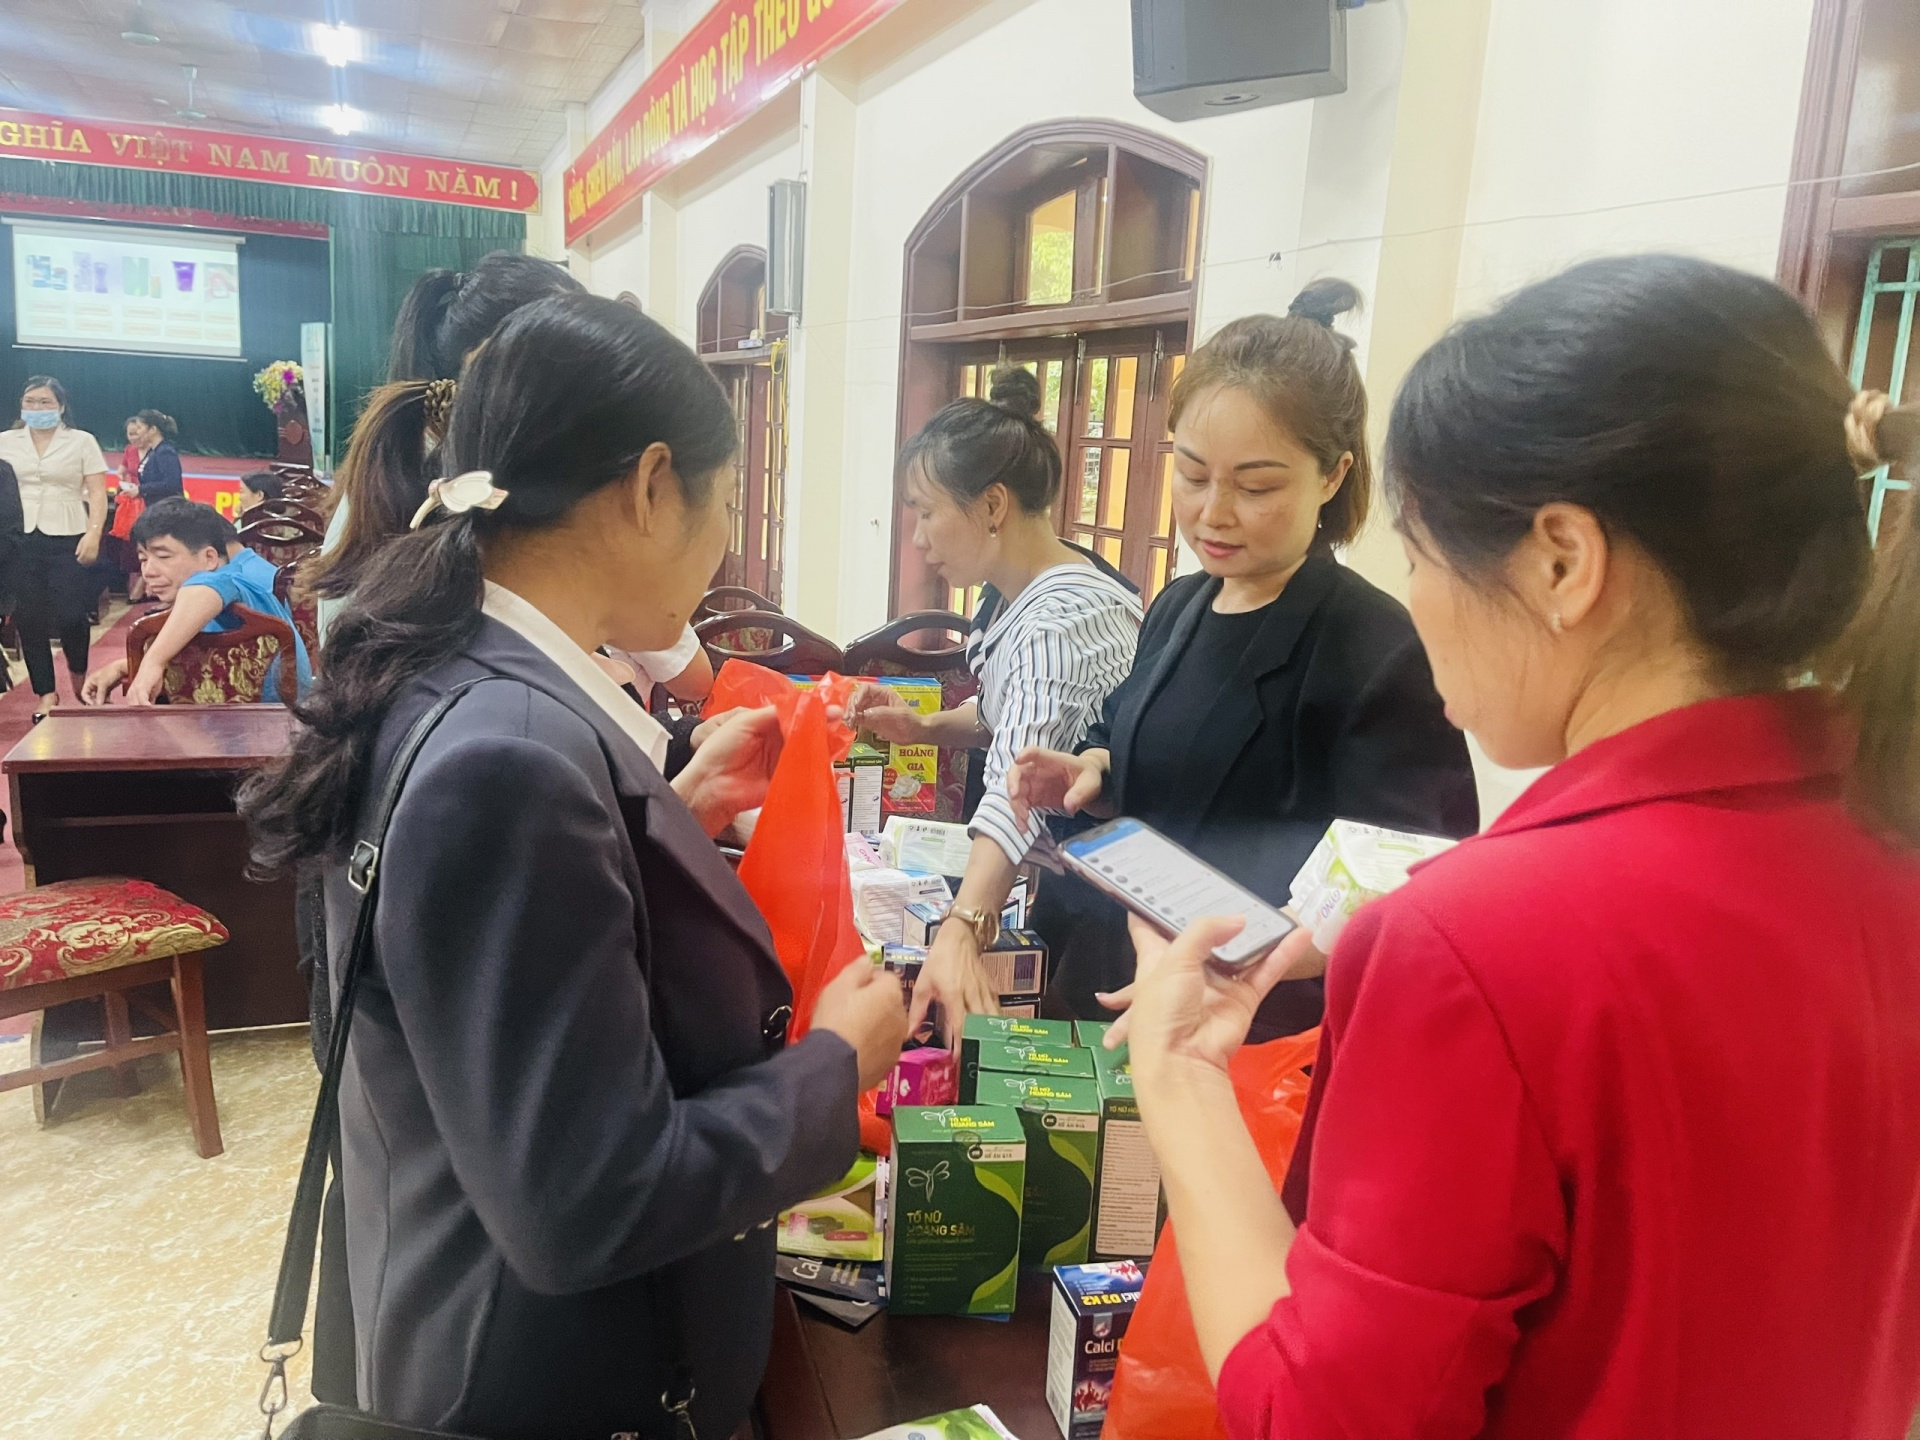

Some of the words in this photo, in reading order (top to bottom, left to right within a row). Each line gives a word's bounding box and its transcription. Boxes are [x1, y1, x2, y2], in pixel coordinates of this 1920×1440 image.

[625, 119, 641, 175] LAO
[643, 92, 671, 166] ĐỘNG
[672, 64, 688, 135] VÀ
[690, 45, 717, 126] HỌC
[720, 11, 749, 102] TẬP
[753, 0, 799, 67] THEO
[0, 119, 91, 154] GHĨA
[107, 130, 193, 166] VIỆT
[208, 143, 290, 174] NAM
[306, 154, 410, 188] MUÔN
[425, 167, 501, 199] NĂM
[907, 762, 925, 771] GIA
[906, 1210, 922, 1224] TỐ
[924, 1210, 942, 1224] NỮ
[906, 1223, 948, 1236] HOÀNG
[950, 1222, 975, 1236] SÂM
[1081, 1295, 1101, 1305] K2
[1101, 1293, 1121, 1304] D3
[1085, 1340, 1114, 1354] Calci
